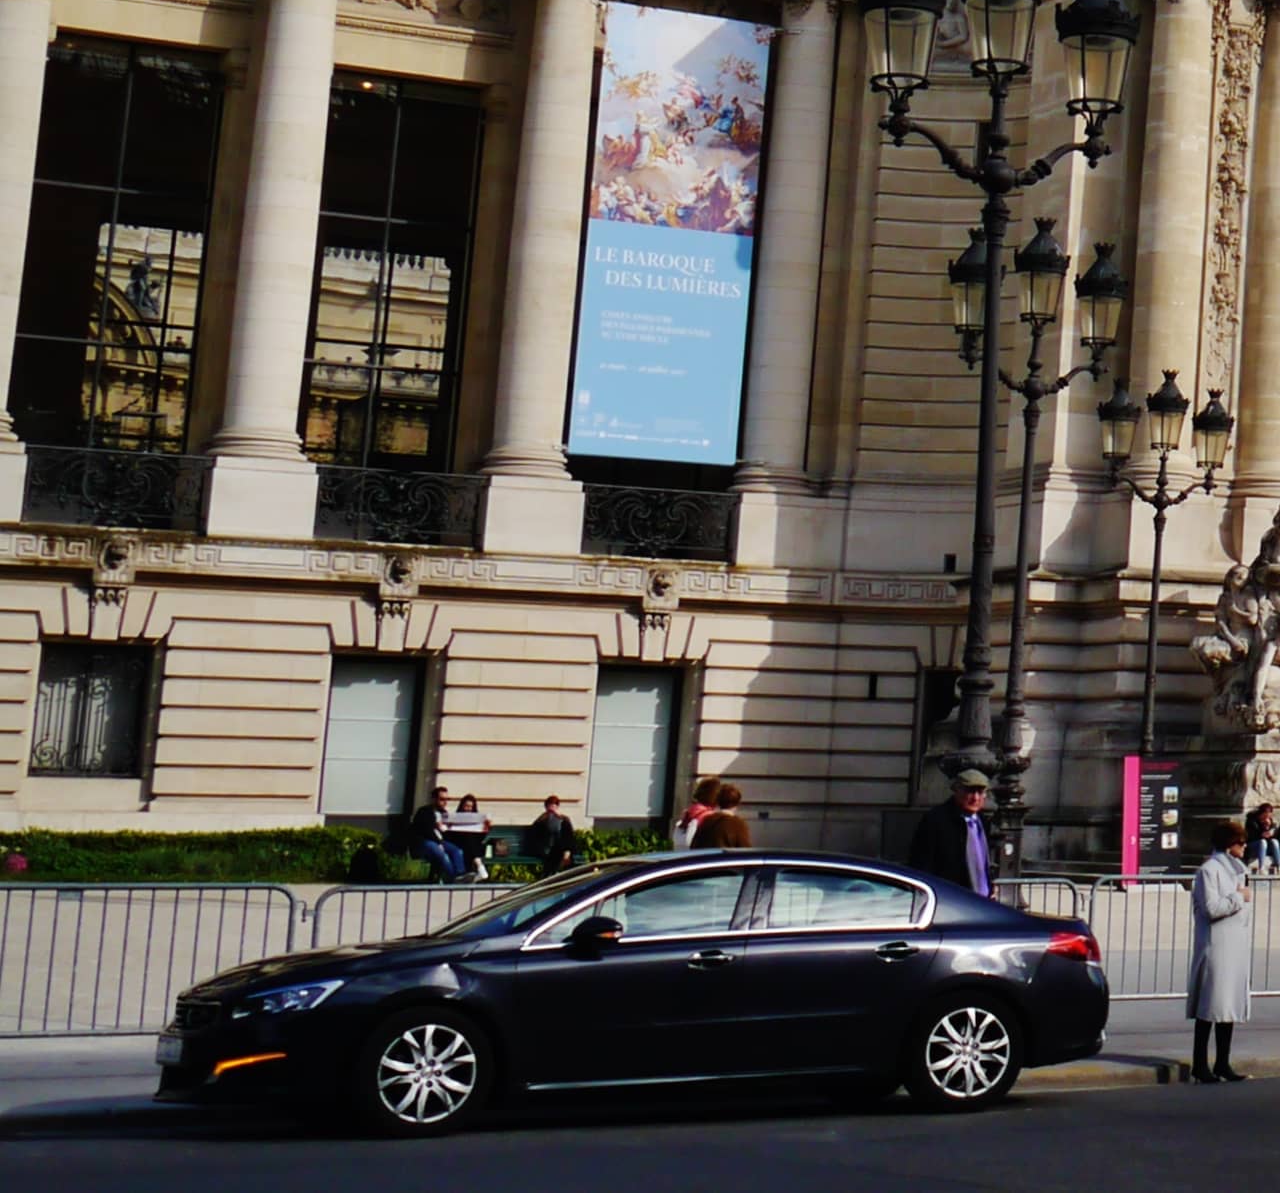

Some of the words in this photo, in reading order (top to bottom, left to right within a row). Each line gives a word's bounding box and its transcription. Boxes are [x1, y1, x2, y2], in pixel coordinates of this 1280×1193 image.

[594, 246, 618, 263] LE
[623, 248, 716, 277] BAROQUE
[605, 269, 643, 288] DES
[647, 273, 742, 299] LUMIÈRES
